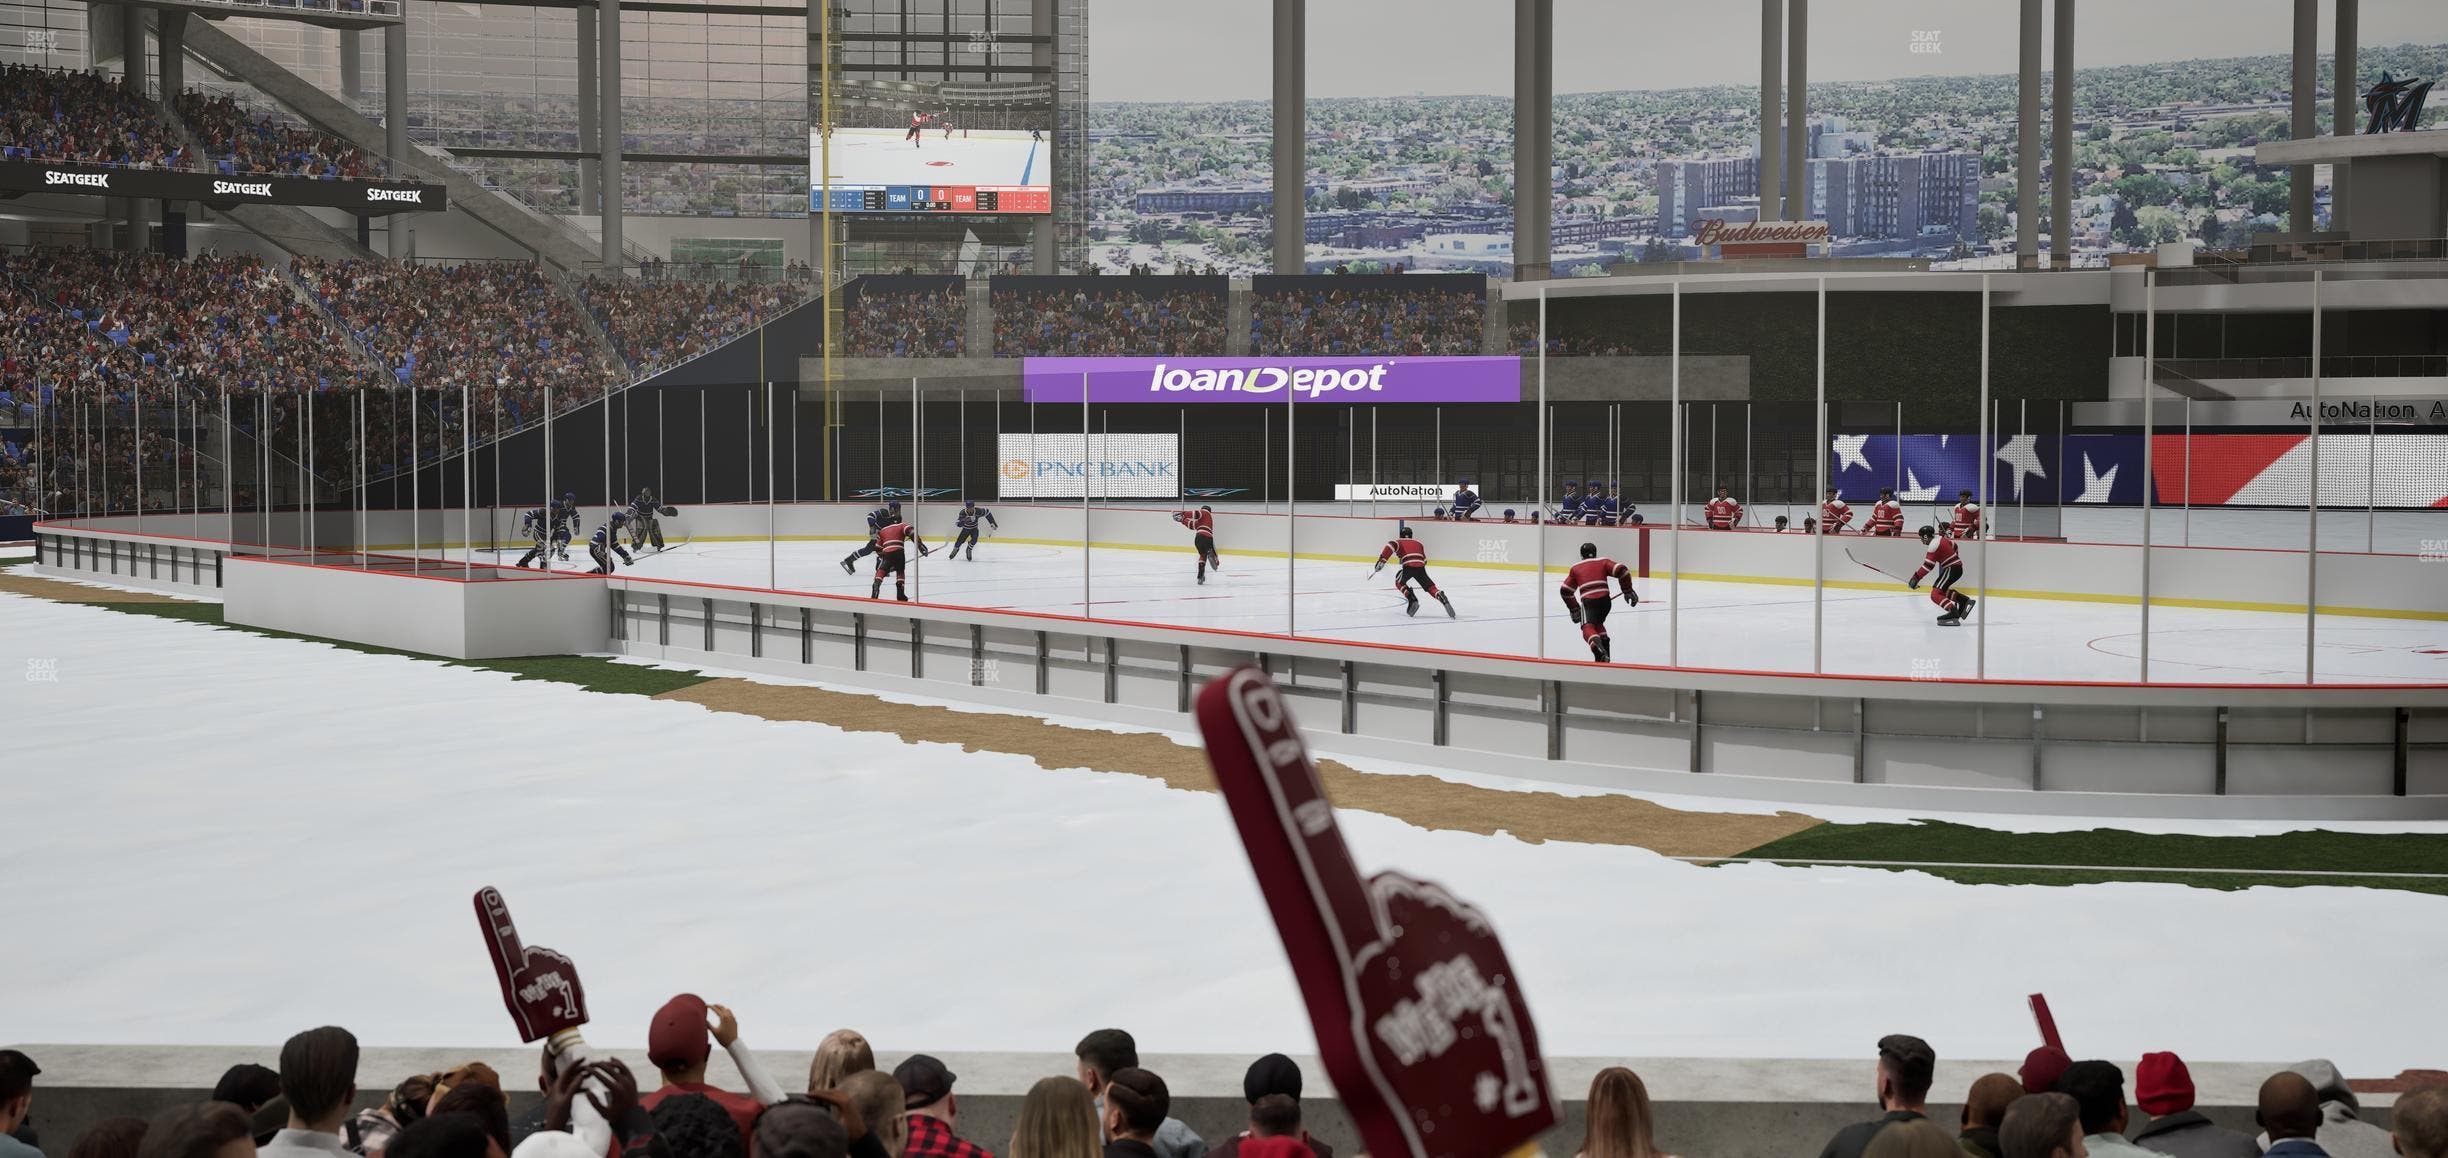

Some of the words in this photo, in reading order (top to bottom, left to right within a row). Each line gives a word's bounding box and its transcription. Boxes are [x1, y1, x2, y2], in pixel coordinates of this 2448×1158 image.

[45, 170, 109, 188] SEATGEEK
[213, 180, 272, 197] SEATGEEK
[366, 187, 421, 203] SEATGEEK
[918, 189, 923, 200] 0
[938, 189, 944, 200] 0
[889, 194, 906, 203] TEAM
[955, 195, 972, 203] TEAM
[1692, 218, 1829, 246] Budweiser
[1150, 363, 1387, 398] loanDepot
[2290, 401, 2415, 418] AutoNation
[1036, 461, 1093, 478] PNC
[1100, 461, 1173, 477] BANK
[1369, 485, 1443, 496] AutoNation
